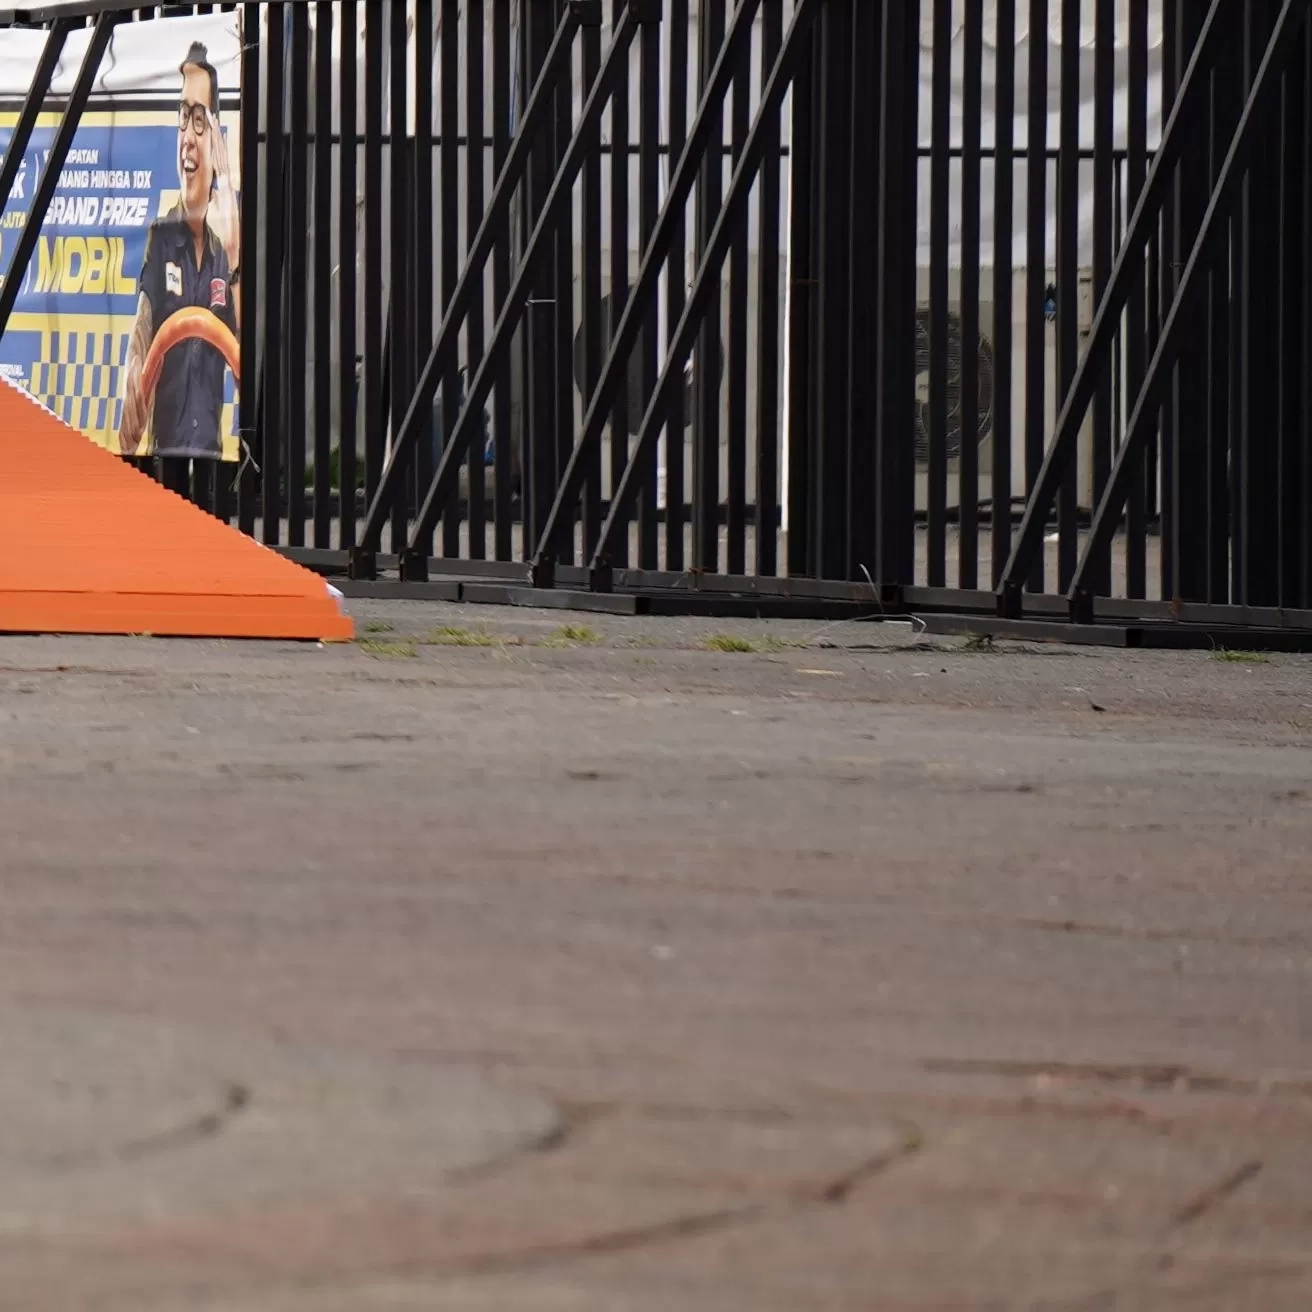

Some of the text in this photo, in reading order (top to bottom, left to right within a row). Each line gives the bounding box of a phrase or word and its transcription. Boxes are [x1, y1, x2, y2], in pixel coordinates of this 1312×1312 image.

[91, 170, 131, 189] HINGGA
[133, 170, 153, 189] 10X
[98, 197, 149, 226] PRIZE
[33, 235, 137, 295] MOBIL
